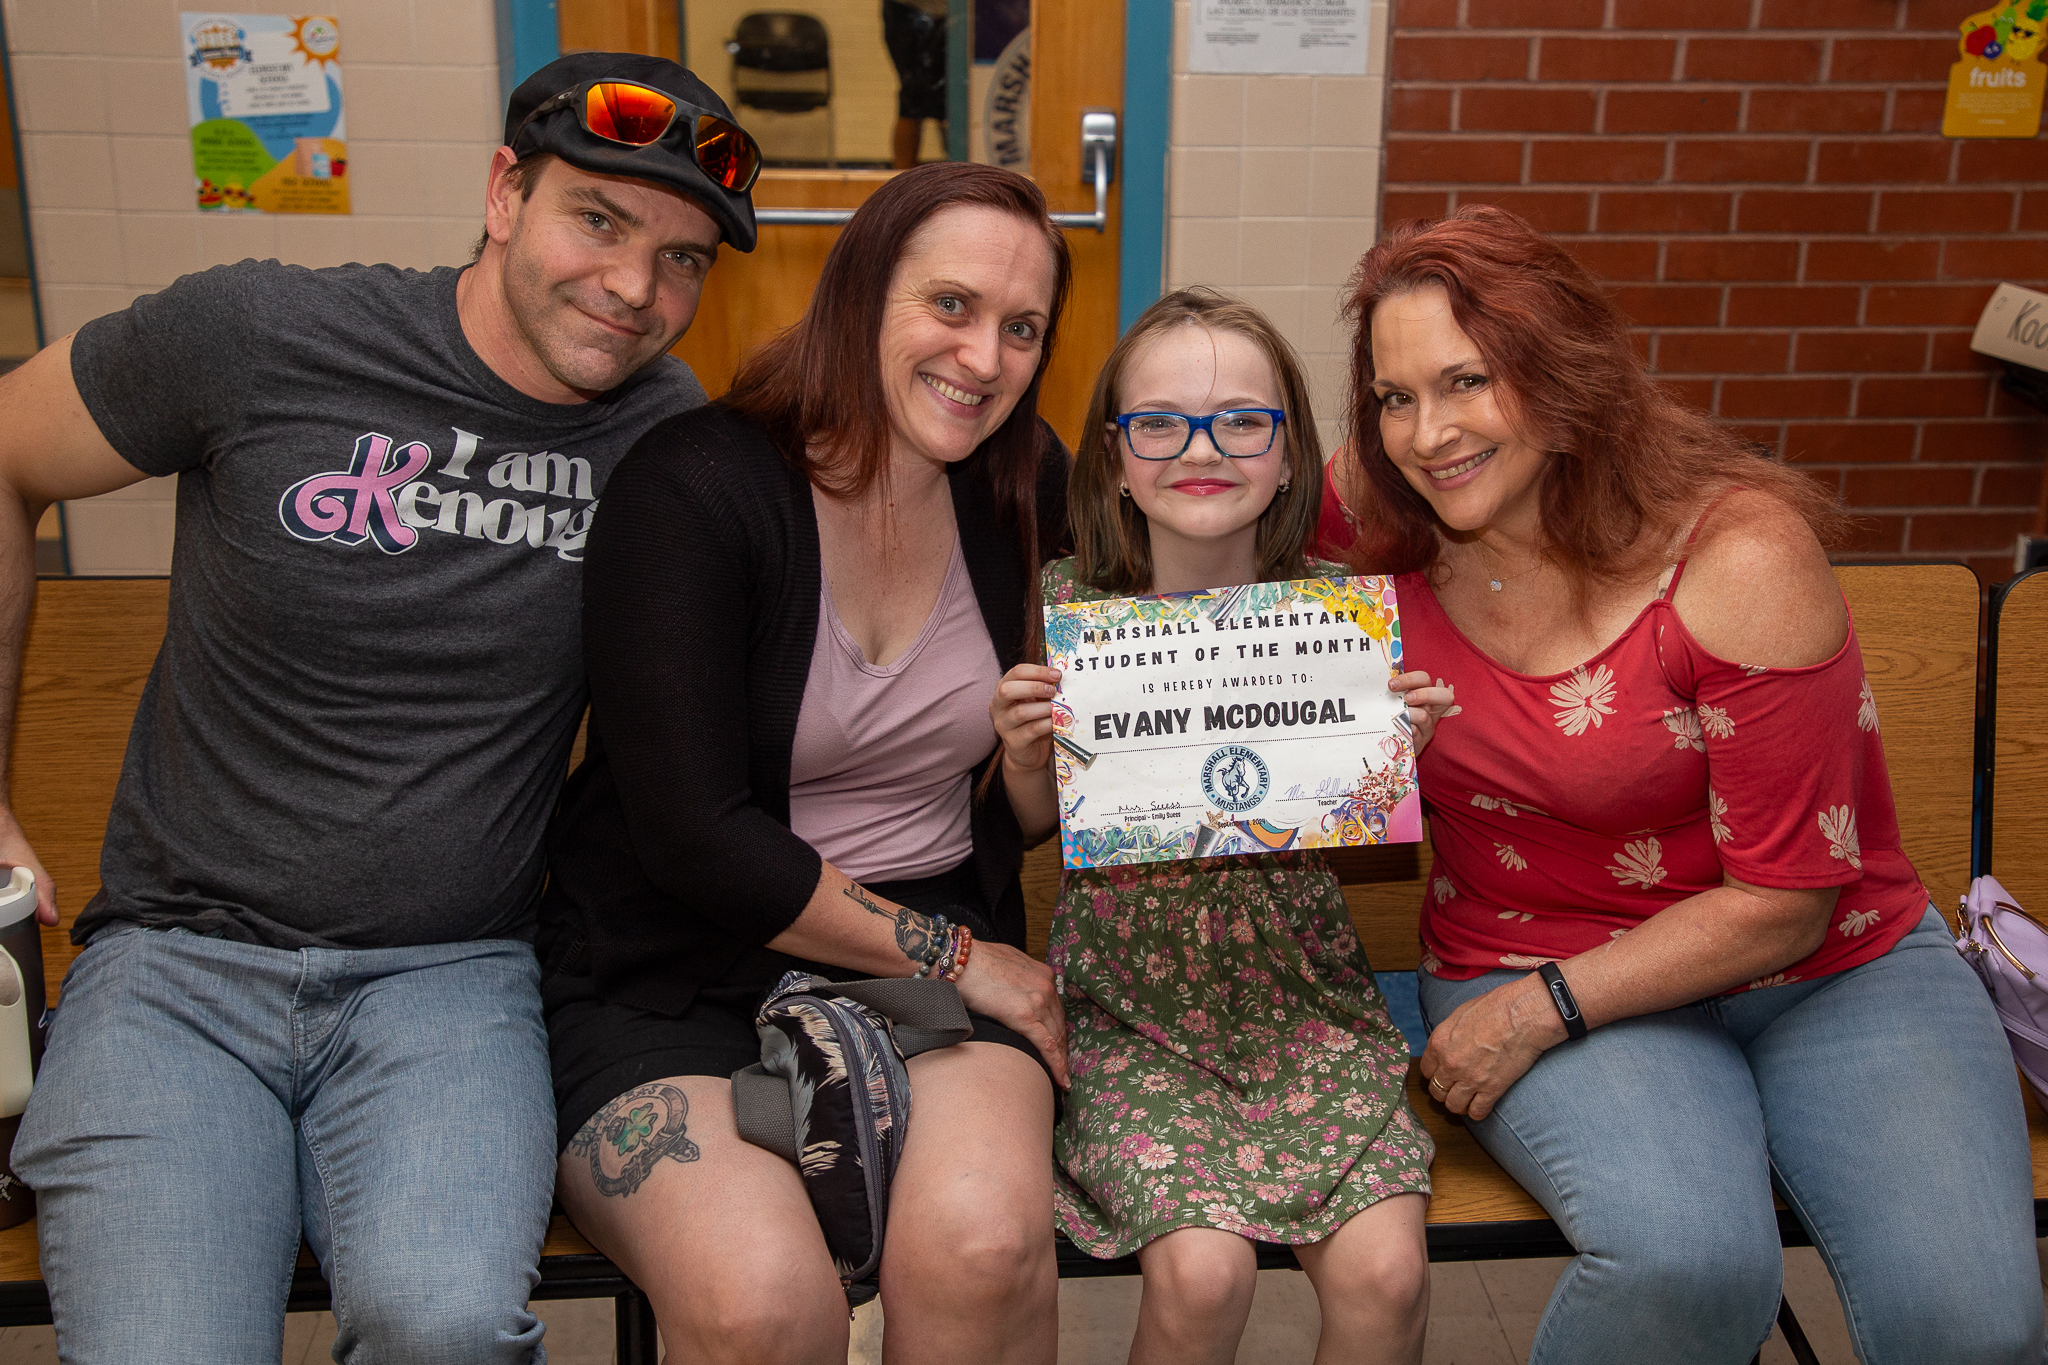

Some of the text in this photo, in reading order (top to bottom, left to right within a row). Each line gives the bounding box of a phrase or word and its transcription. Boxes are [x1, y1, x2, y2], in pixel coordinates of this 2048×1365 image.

[1969, 66, 2027, 88] fruits
[438, 426, 596, 500] I am
[1083, 609, 1360, 644] MARSHALL ELEMENTARY
[1074, 637, 1371, 672] STUDENT OF THE MONTH
[1142, 673, 1314, 694] IS HEREBY AWARDED TO:
[1094, 697, 1356, 741] EVANY MCDOUGAL
[1203, 747, 1268, 794] MARSHALL ELEMENTARY
[1215, 794, 1261, 811] MUSTANGS
[1317, 799, 1338, 807] Teacher
[1124, 814, 1147, 823] Principal
[1151, 812, 1166, 821] Emily
[1166, 811, 1181, 819] Suess
